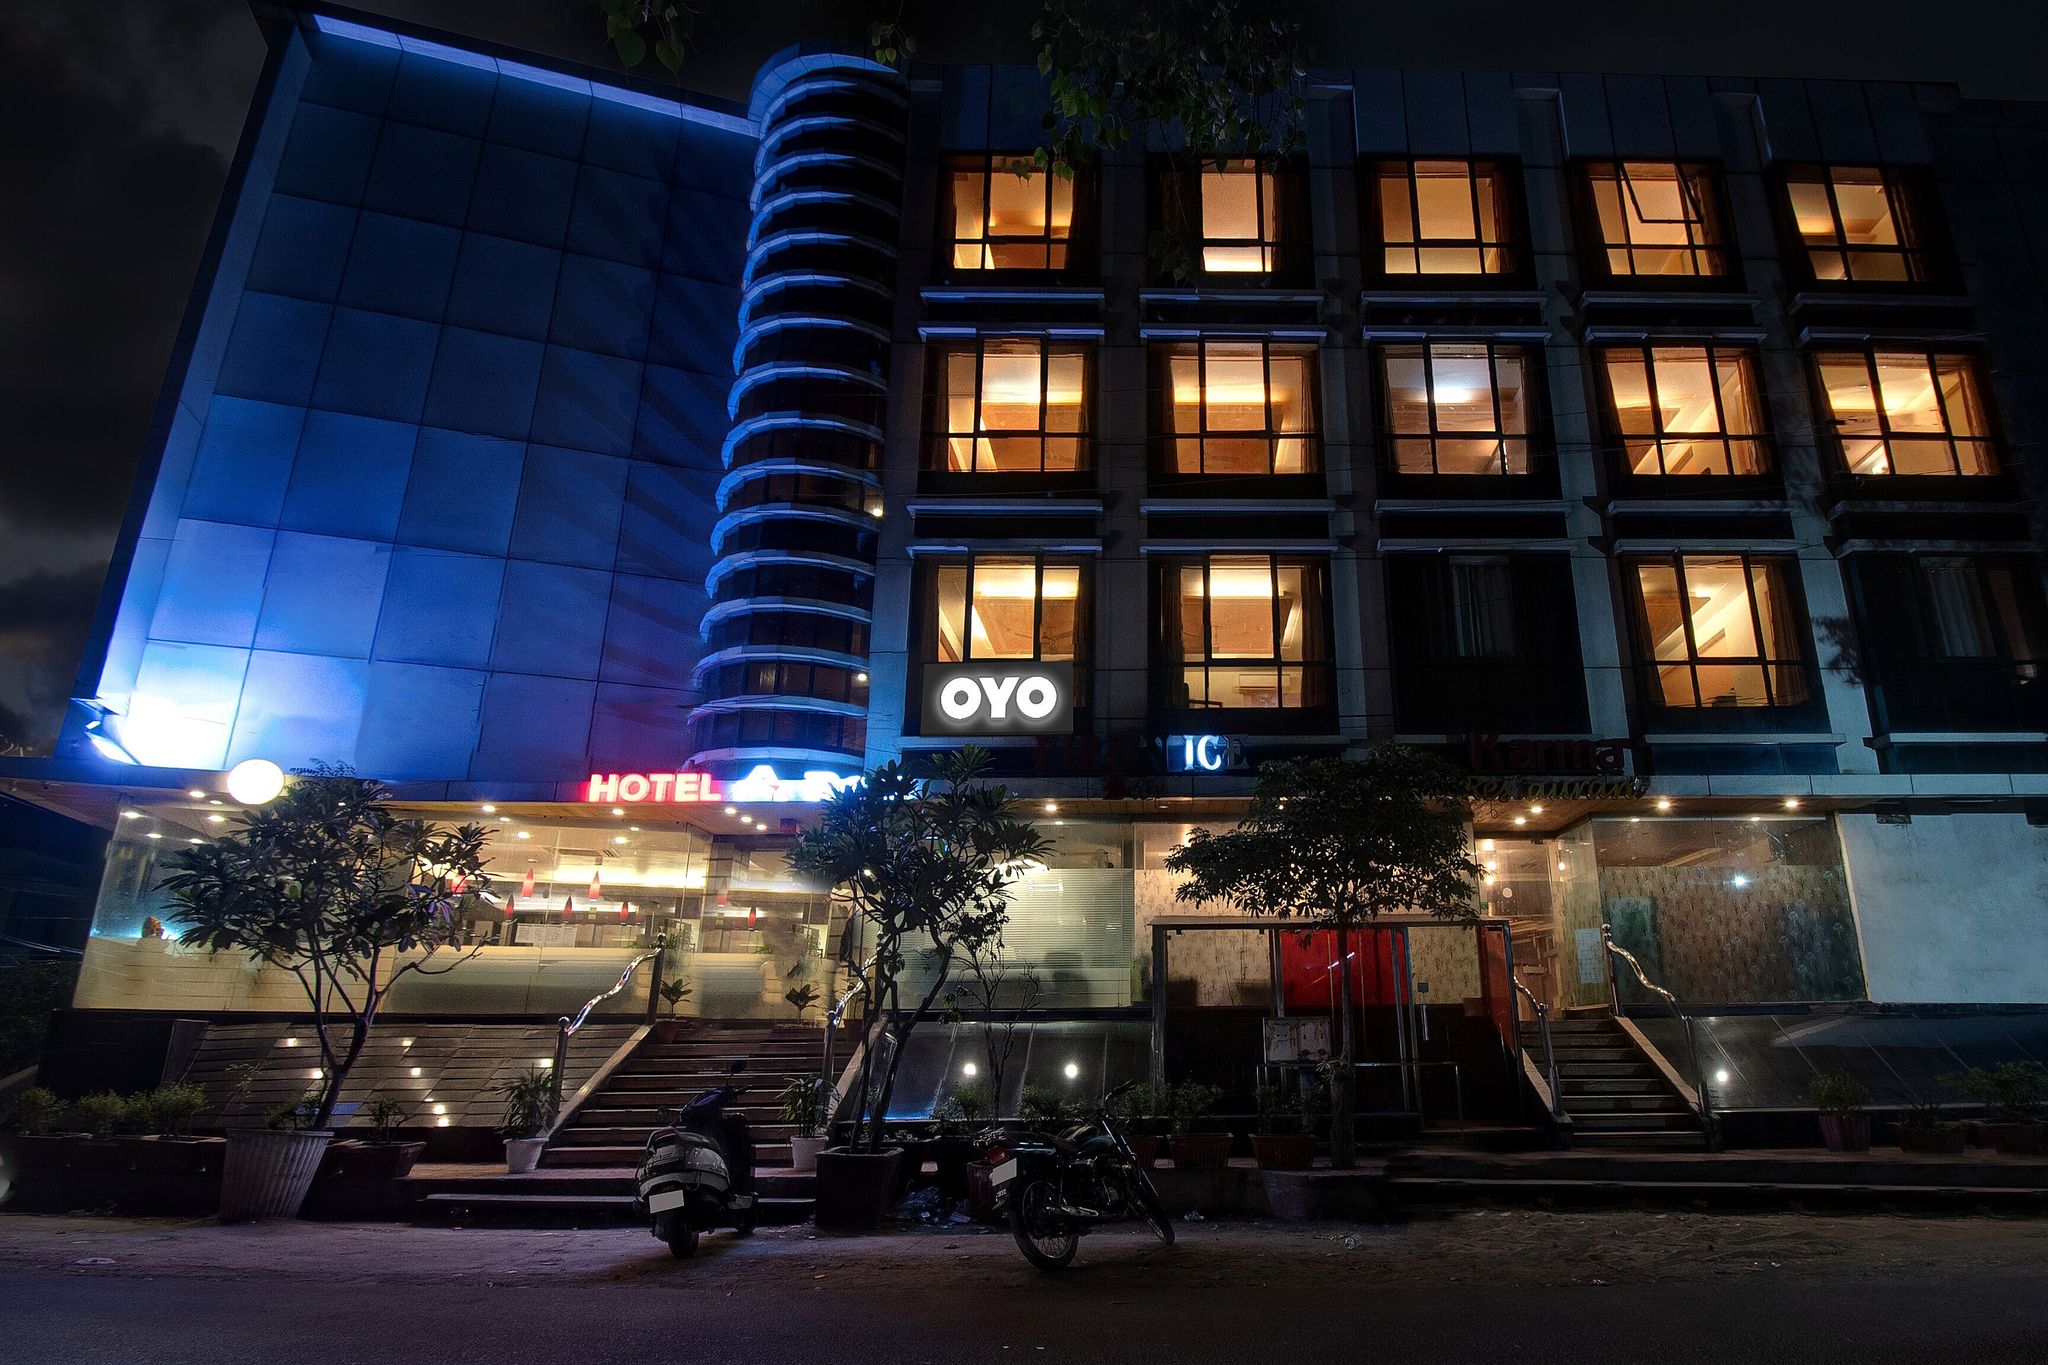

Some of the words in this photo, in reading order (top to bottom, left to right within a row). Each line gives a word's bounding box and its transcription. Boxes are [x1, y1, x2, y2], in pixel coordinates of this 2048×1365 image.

[940, 675, 1058, 720] OYO
[1182, 733, 1251, 771] ICE
[1470, 728, 1625, 770] Karma
[587, 773, 722, 803] HOTEL
